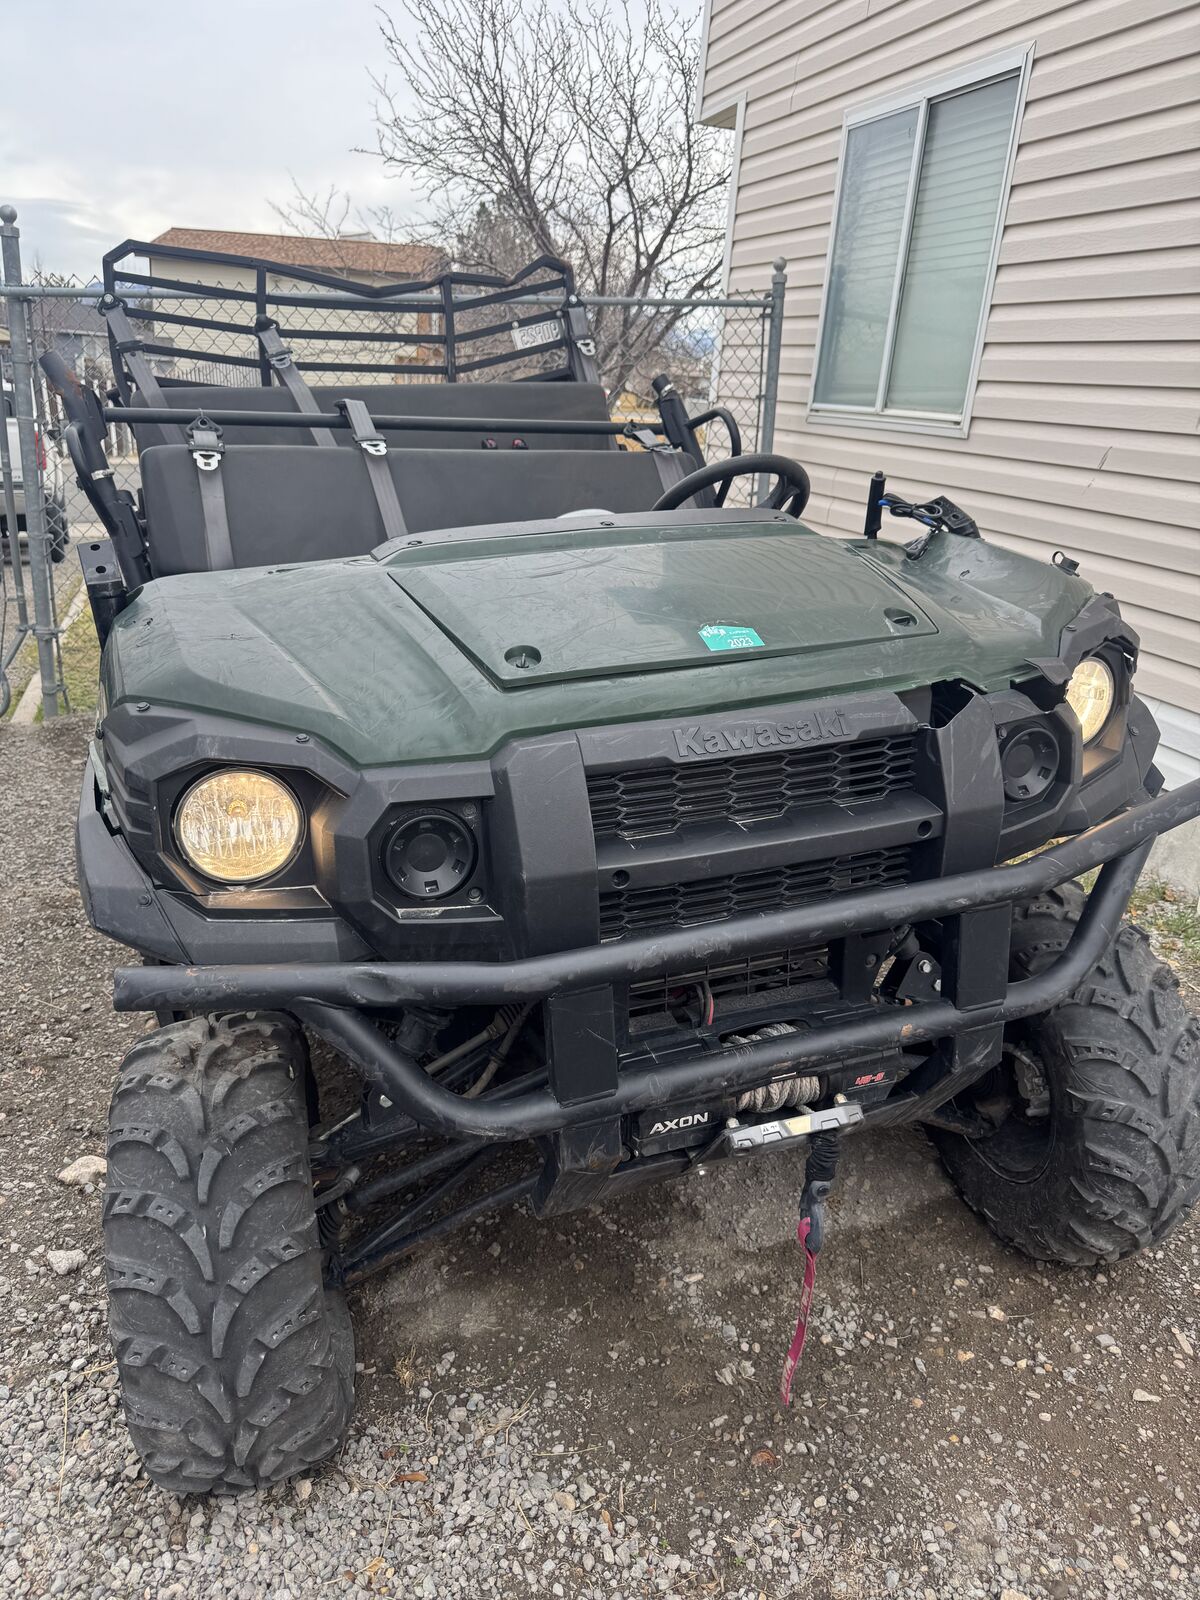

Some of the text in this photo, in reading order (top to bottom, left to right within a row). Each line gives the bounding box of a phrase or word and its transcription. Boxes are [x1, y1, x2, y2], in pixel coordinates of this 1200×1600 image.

[728, 638, 754, 648] 2023
[672, 708, 851, 758] Kawasaki
[649, 1111, 709, 1135] AXON
